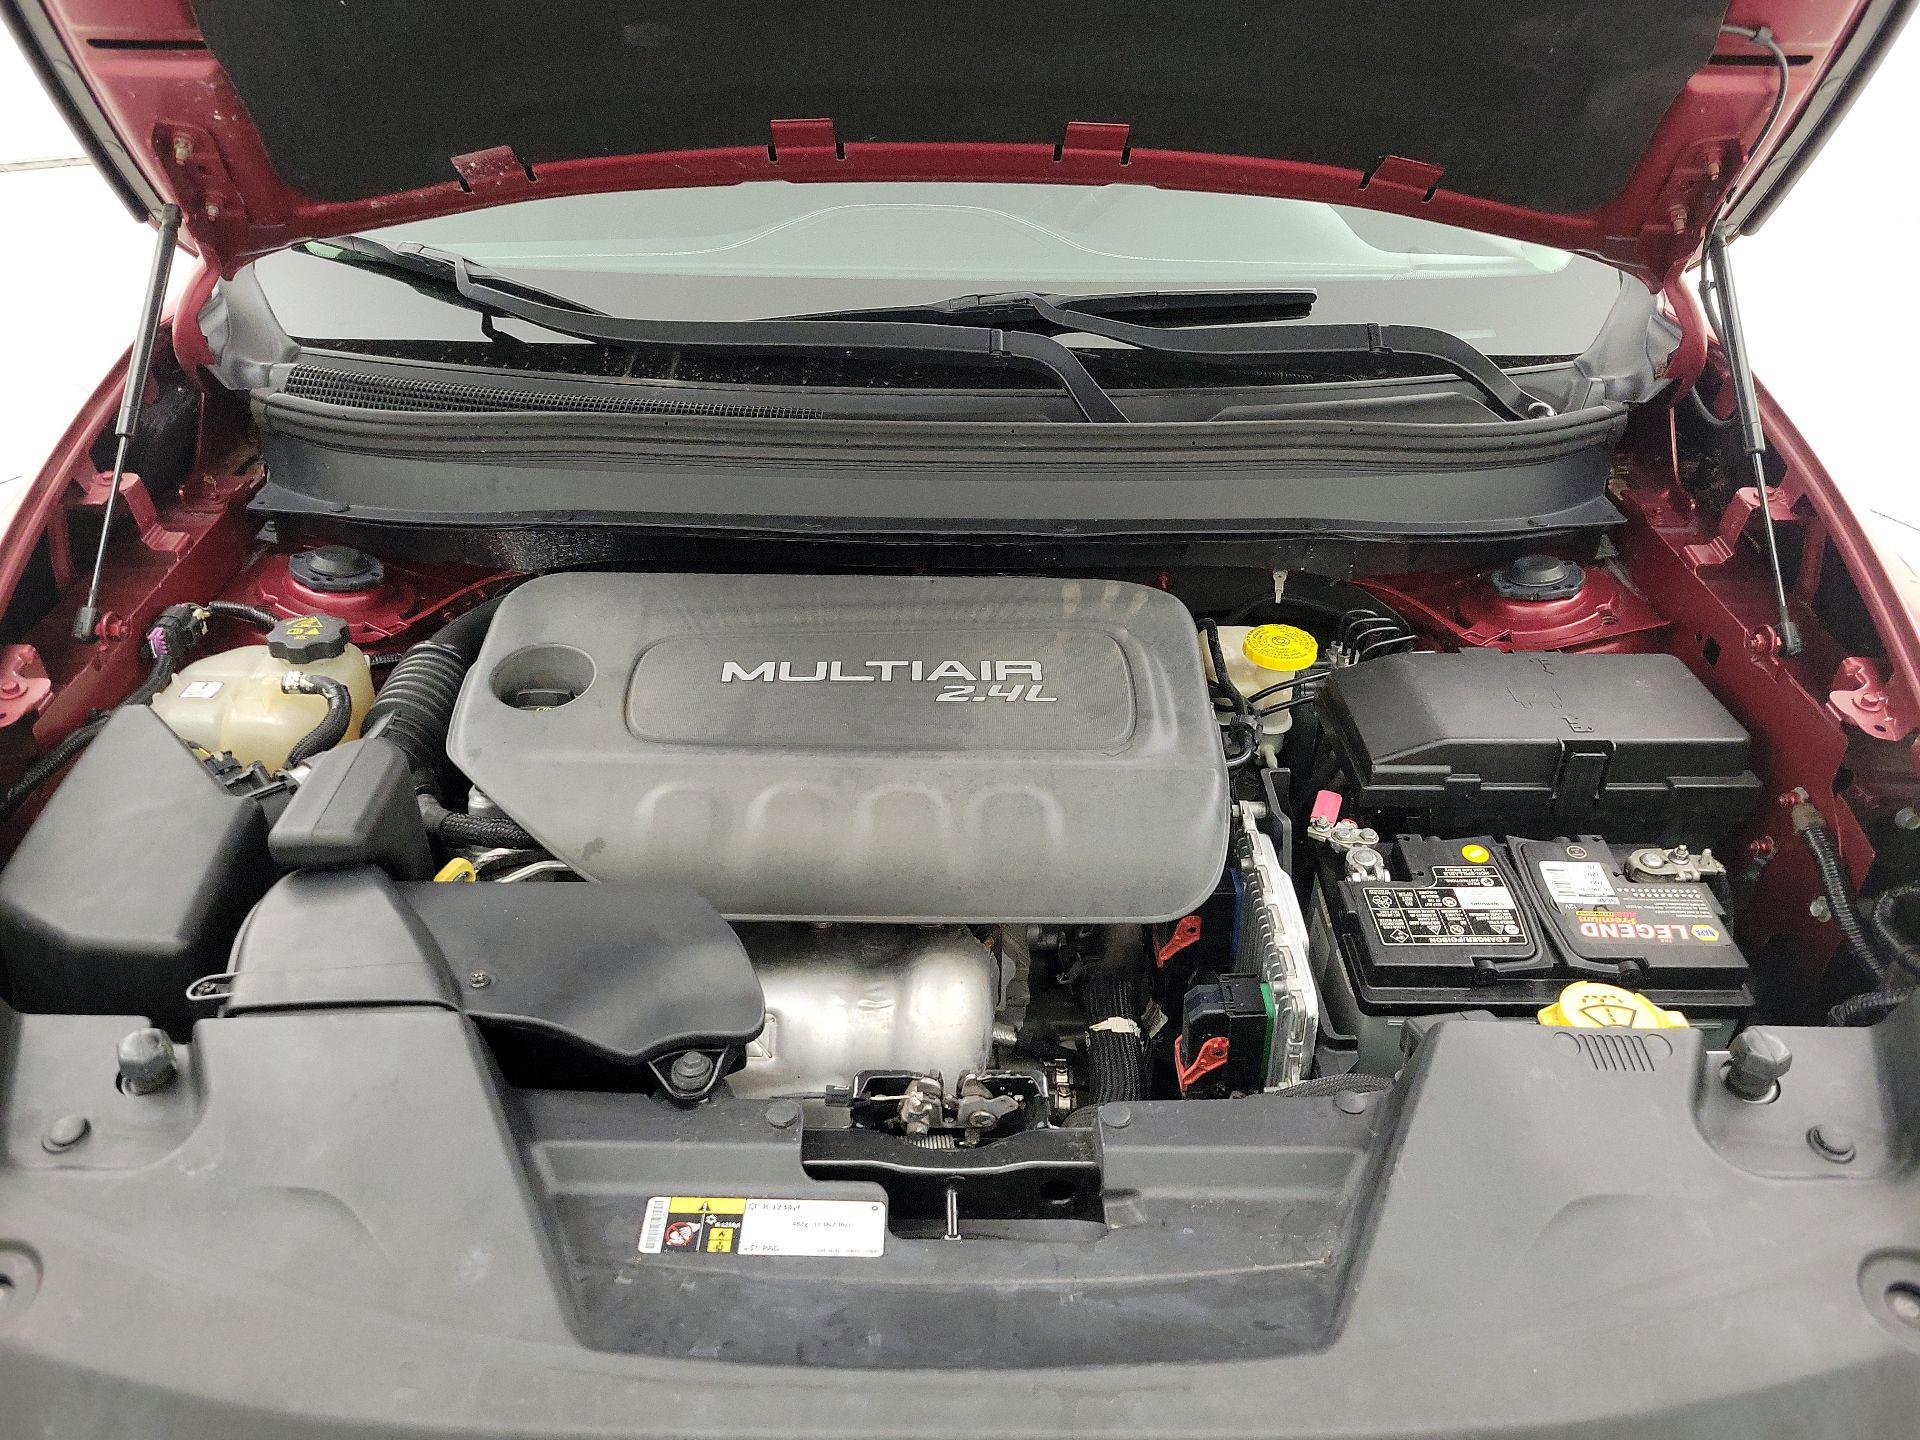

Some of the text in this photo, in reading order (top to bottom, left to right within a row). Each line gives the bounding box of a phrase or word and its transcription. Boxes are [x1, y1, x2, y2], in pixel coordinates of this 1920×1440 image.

[720, 660, 1044, 683] MULTIAIR
[934, 684, 1059, 703] 2.4L
[1577, 916, 1637, 925] Premium
[1580, 922, 1715, 940] NAPA LEGEND
